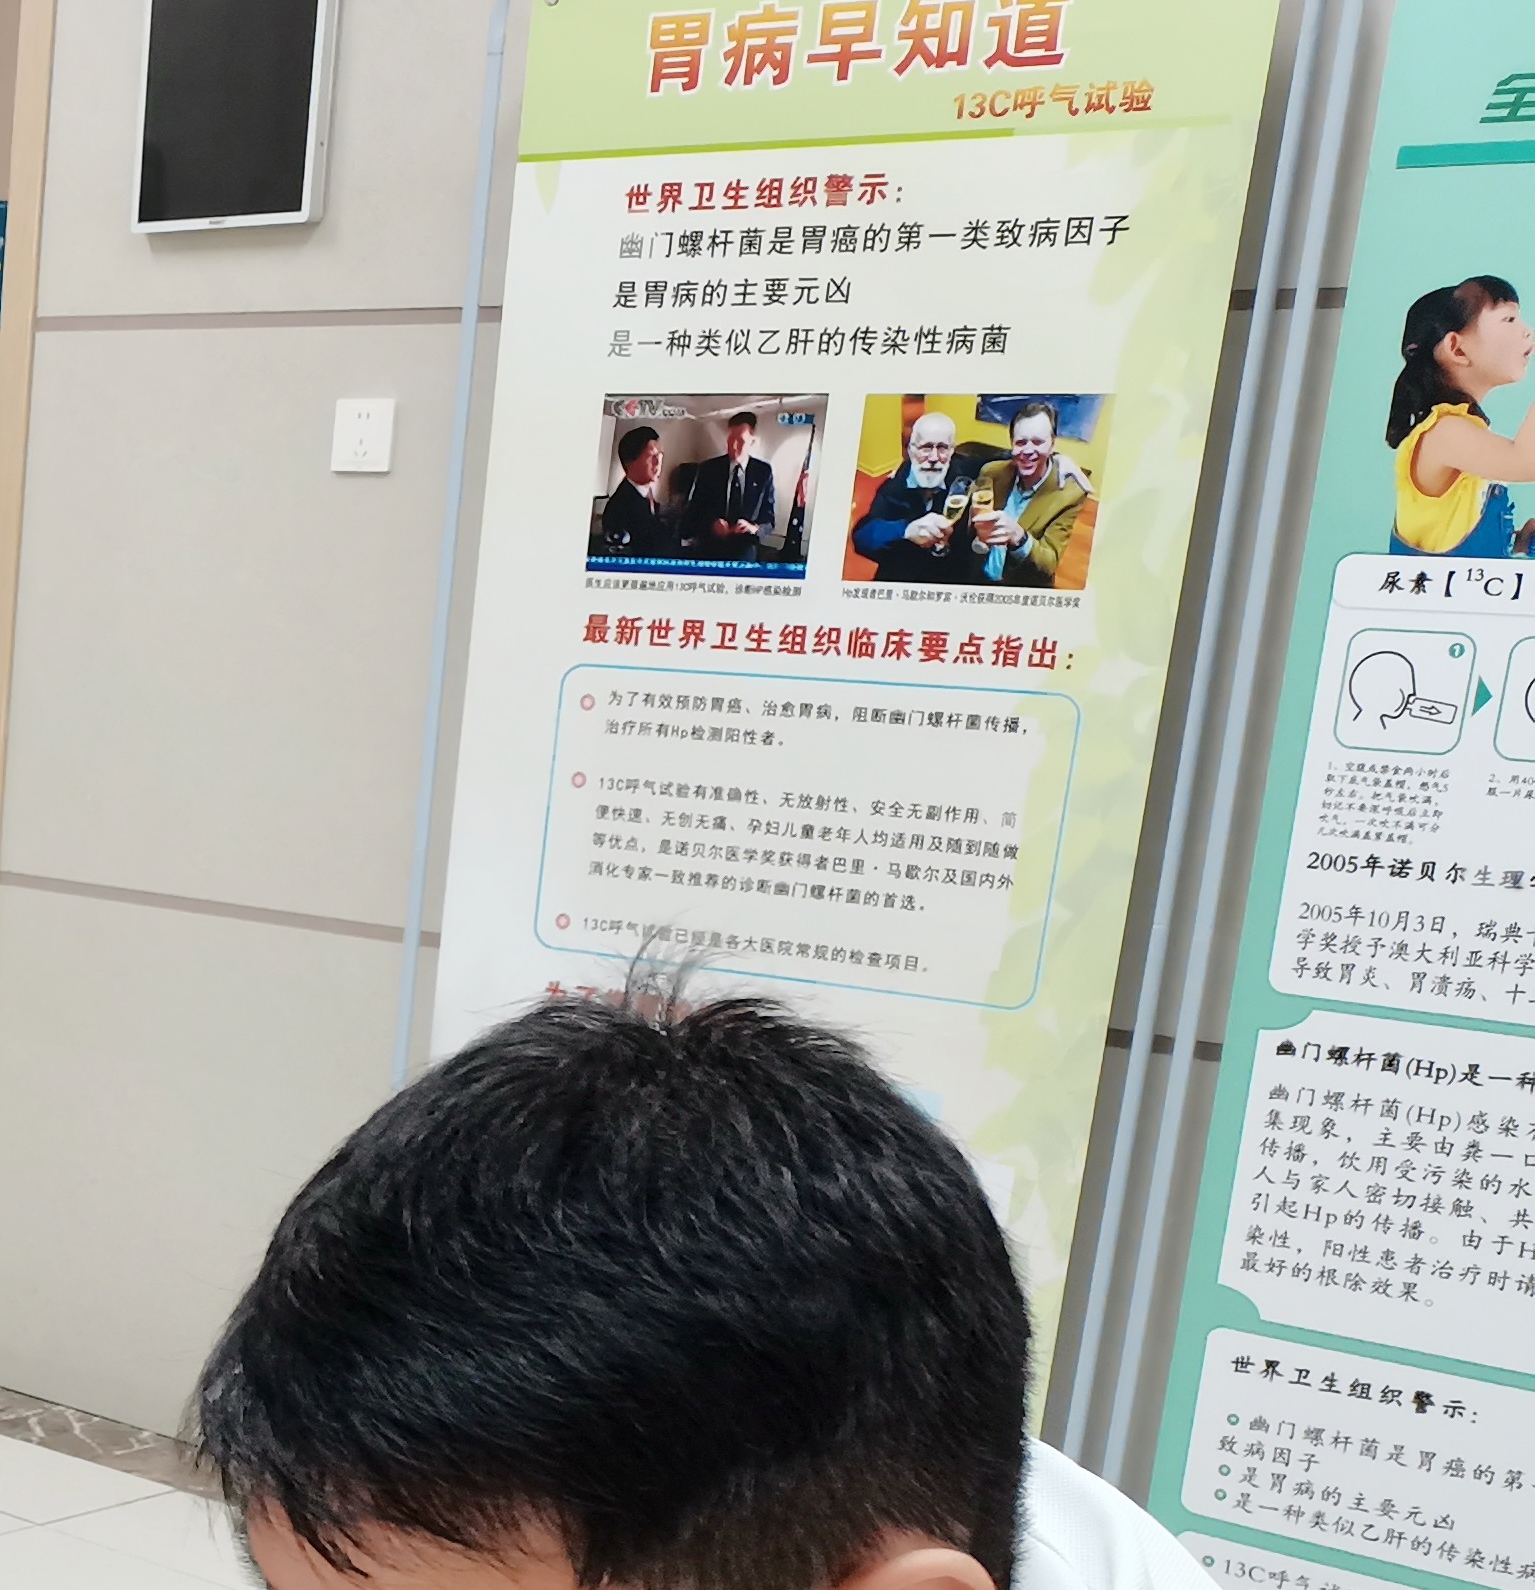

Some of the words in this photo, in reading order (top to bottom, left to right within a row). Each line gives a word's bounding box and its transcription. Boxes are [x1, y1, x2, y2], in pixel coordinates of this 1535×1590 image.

[647, 0, 1069, 93] 胃病早知道
[953, 78, 1155, 122] 13C呼气试验
[618, 214, 1131, 260] 幽门螺杆菌是胃癌的第一类致病因子
[613, 277, 852, 311] 是胃病的主要元凶
[607, 325, 1012, 360] 是一种类似乙肝的传染性病菌
[1306, 851, 1535, 890] 2005年诺贝尔生理
[1291, 956, 1535, 1006] 导致胃炎、胃溃疡、十
[1216, 1434, 1321, 1474] 致病因子
[1248, 1415, 1535, 1493] 幽门螺杆菌是胃癌的第
[1238, 1466, 1456, 1532] 是胃病的主要元凶
